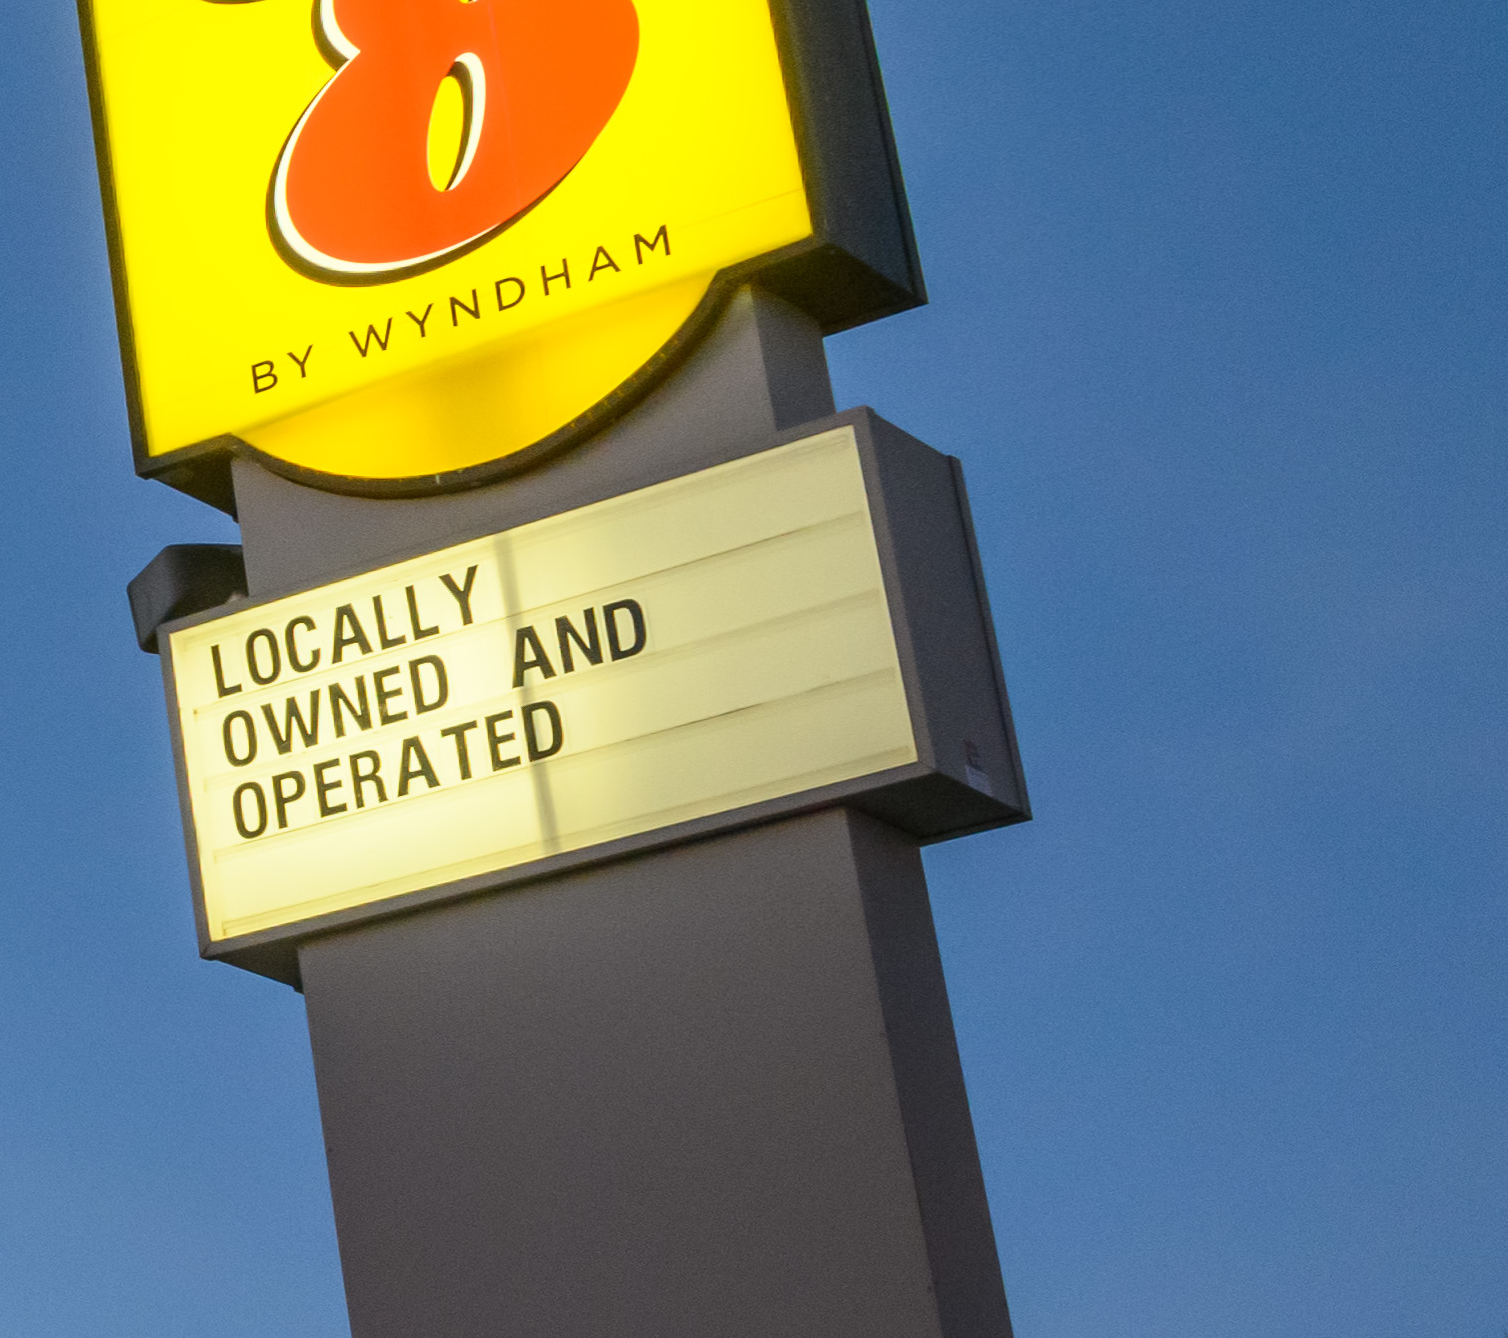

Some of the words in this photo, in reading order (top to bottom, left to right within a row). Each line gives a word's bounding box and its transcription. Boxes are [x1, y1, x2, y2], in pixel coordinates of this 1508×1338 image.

[250, 345, 315, 395] BY
[349, 222, 675, 360] WYNDHAM
[209, 564, 480, 699] LOCALLY
[221, 653, 450, 768] OWNED
[511, 597, 648, 689] AND
[232, 699, 564, 840] OPERATED
